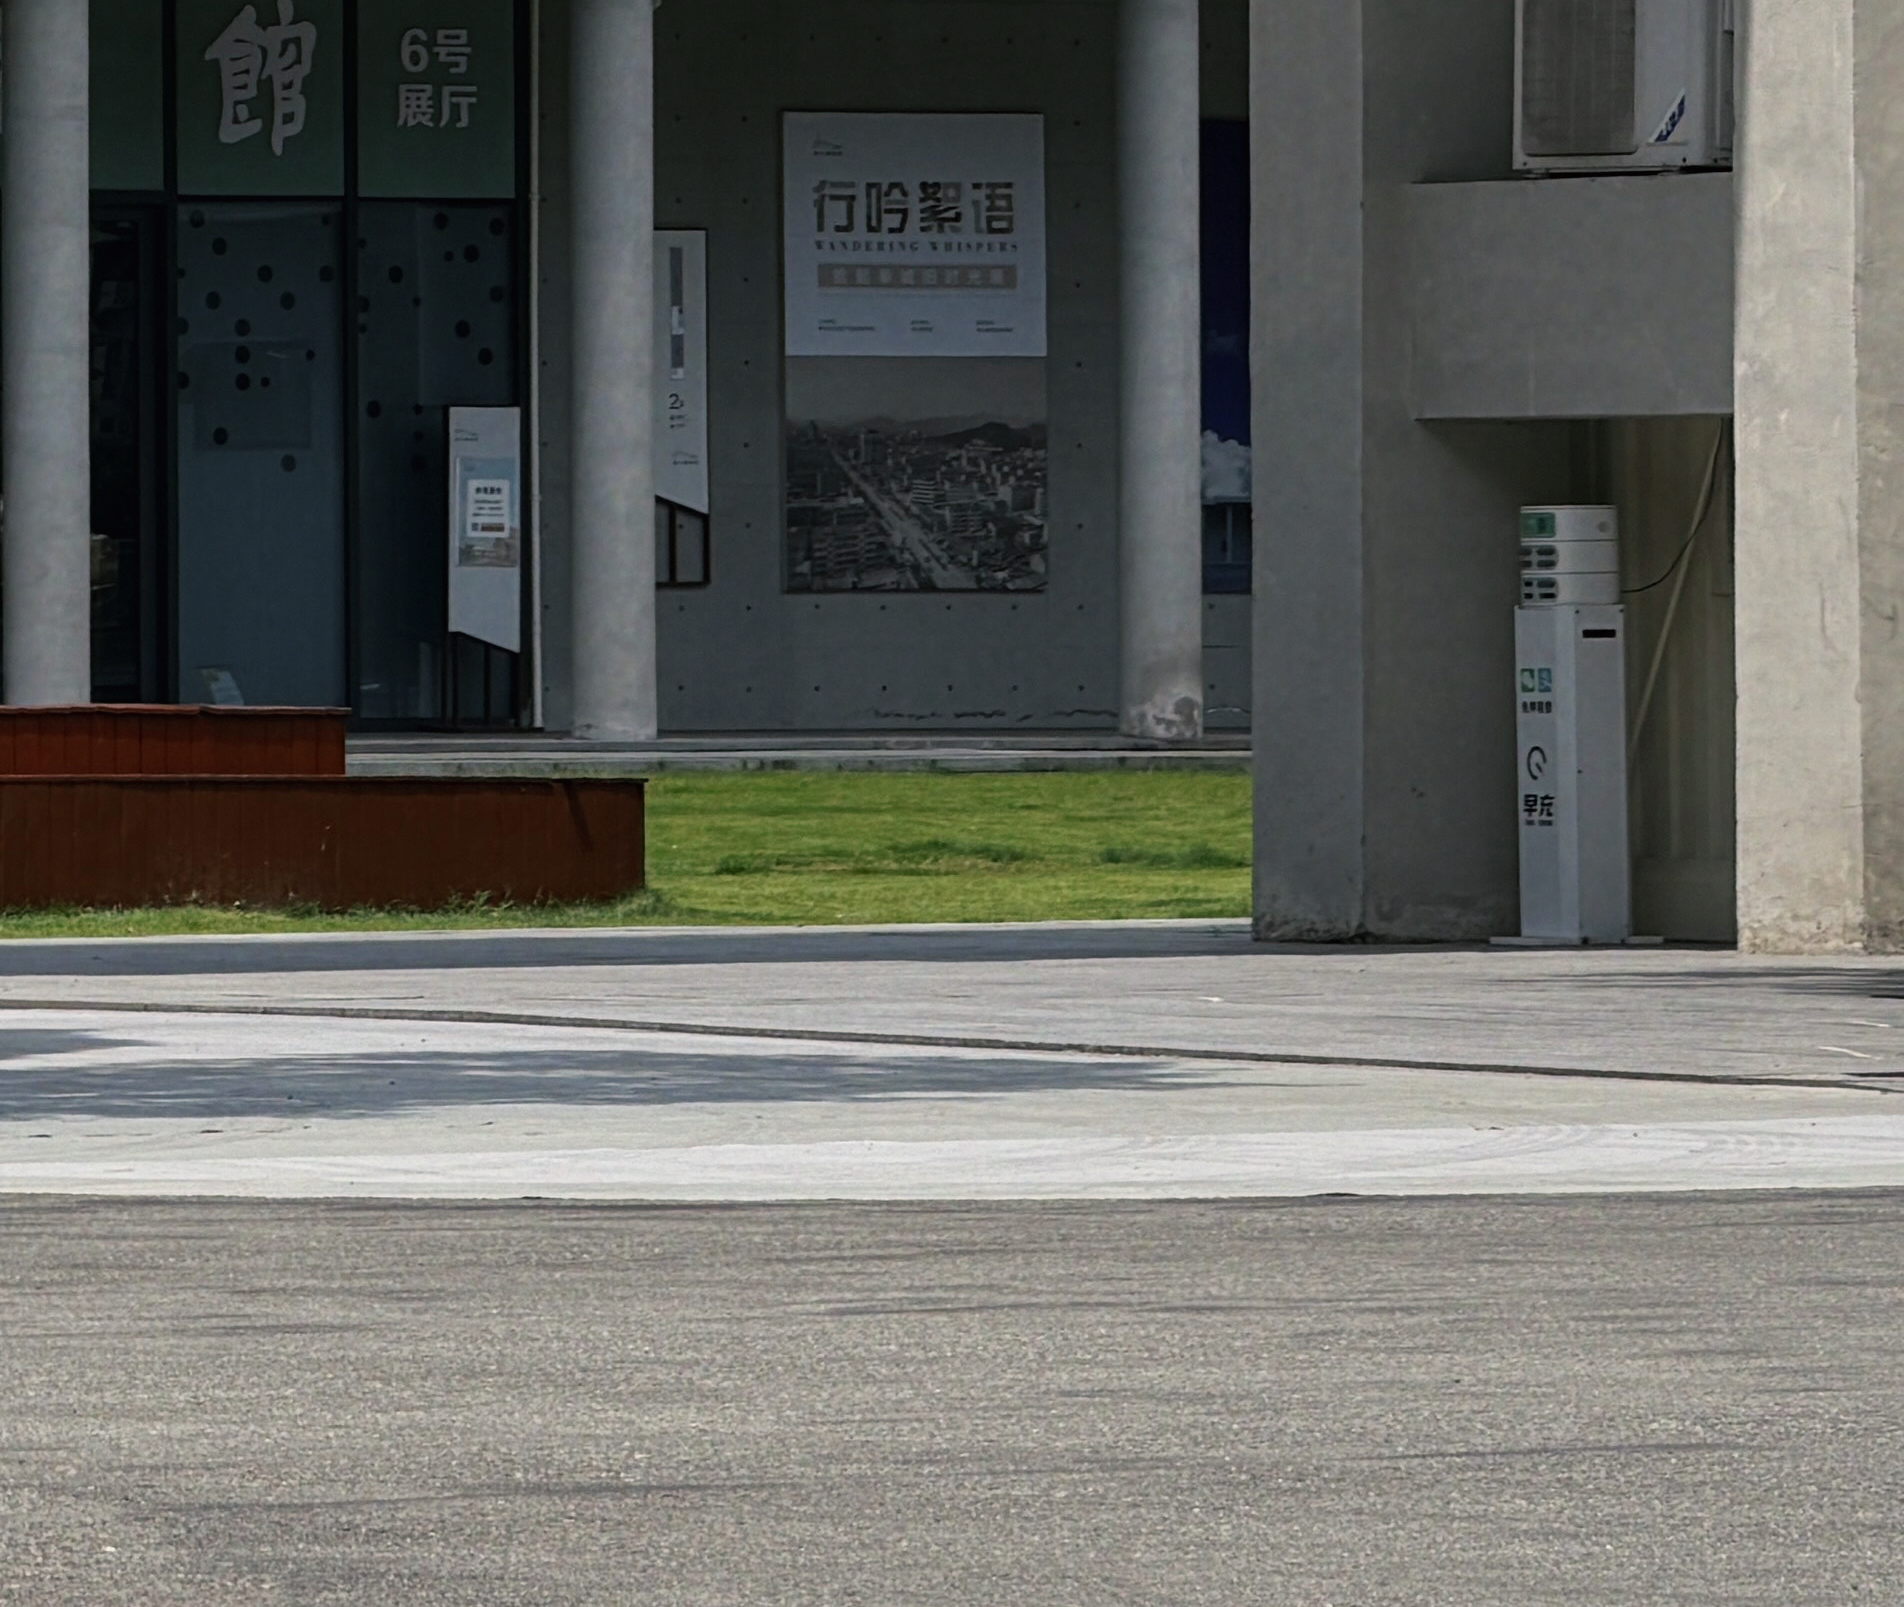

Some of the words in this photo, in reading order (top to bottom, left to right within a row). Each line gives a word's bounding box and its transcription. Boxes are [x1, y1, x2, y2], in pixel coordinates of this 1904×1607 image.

[400, 27, 473, 75] 6号
[395, 83, 479, 129] 展厅
[812, 179, 1015, 234] 行吟絮语
[815, 240, 919, 252] WANDERING
[929, 240, 1017, 252] WHISPERS
[1523, 794, 1556, 817] 早充
